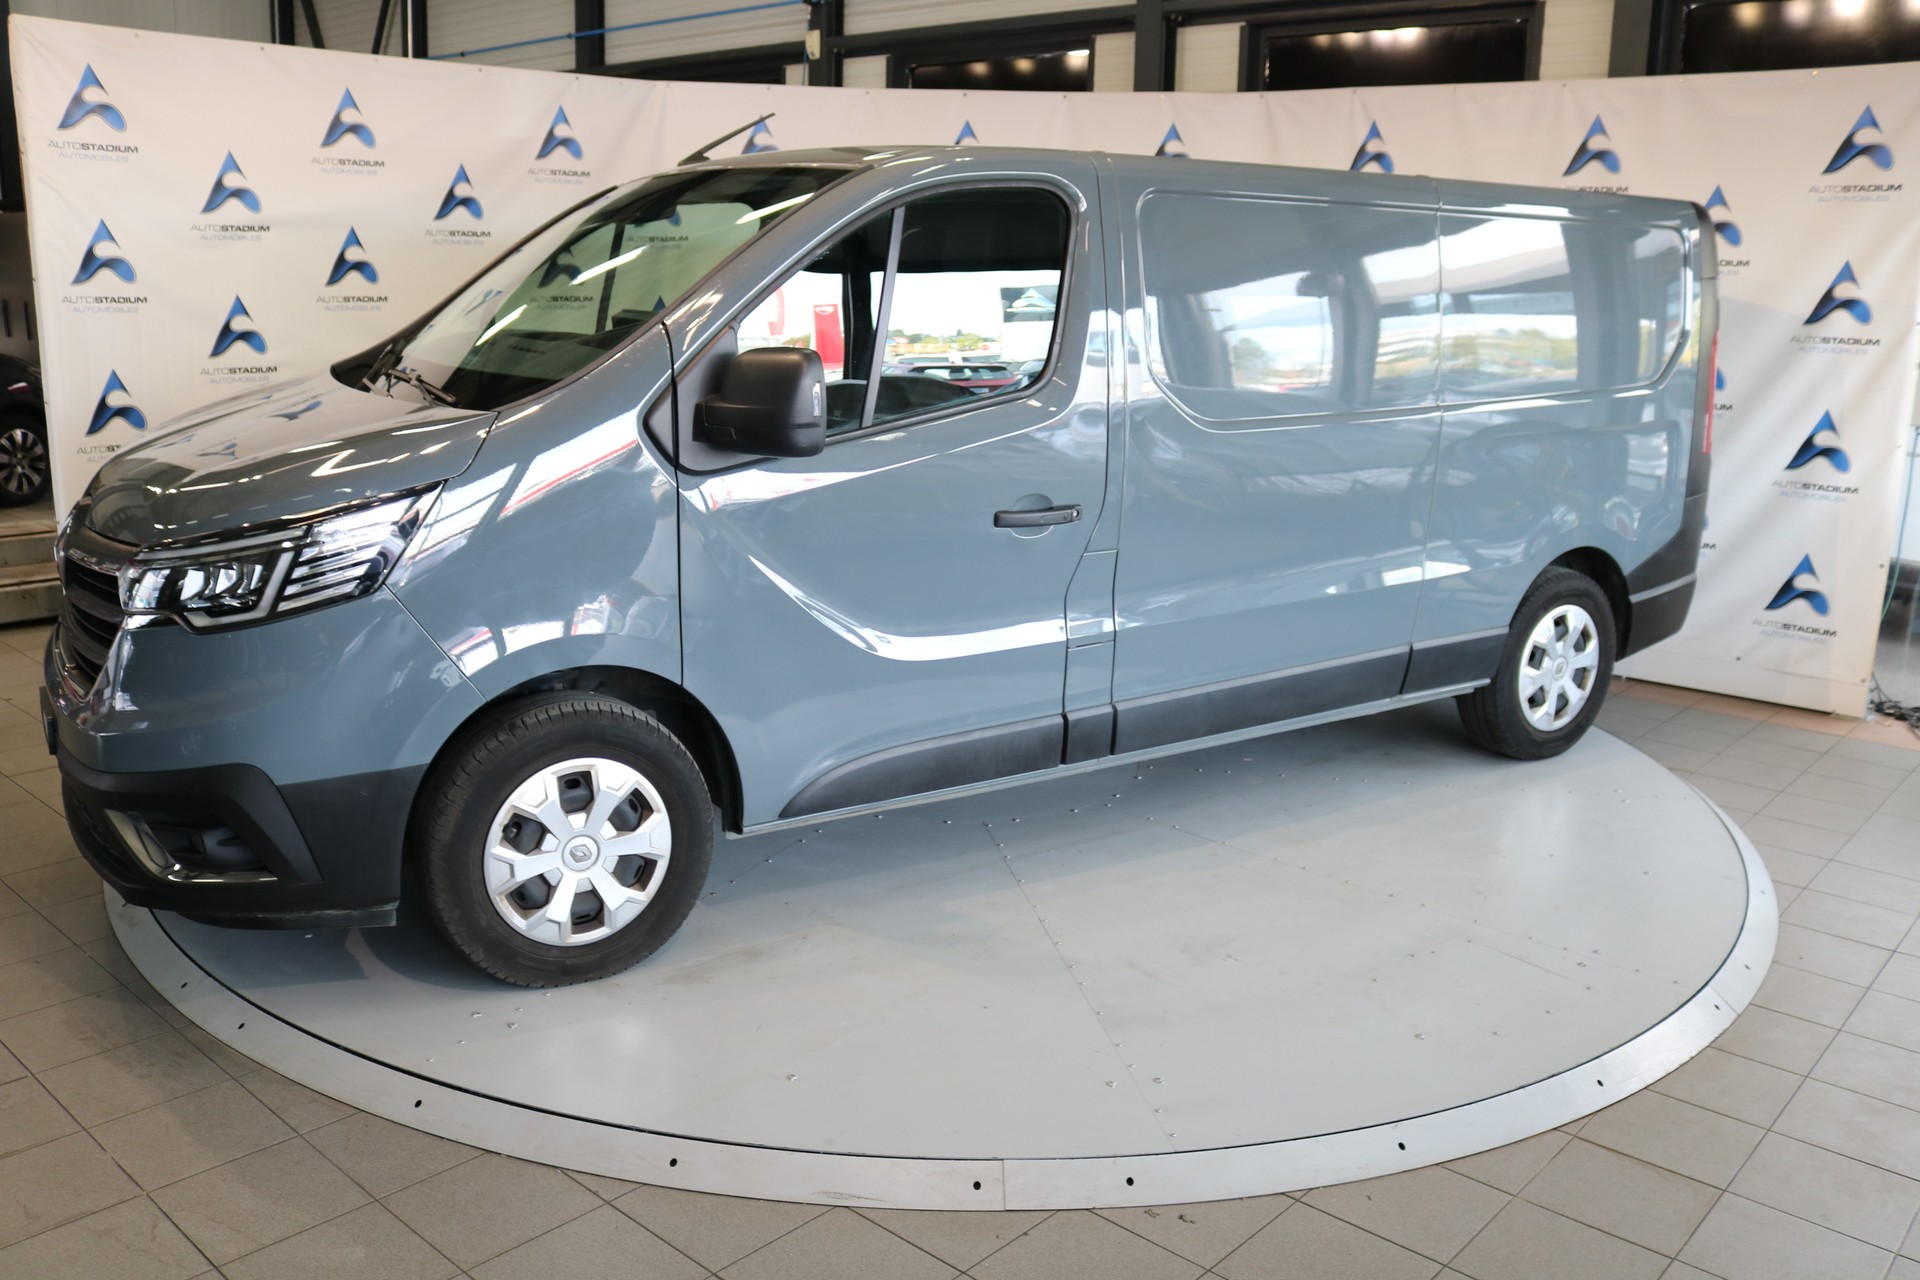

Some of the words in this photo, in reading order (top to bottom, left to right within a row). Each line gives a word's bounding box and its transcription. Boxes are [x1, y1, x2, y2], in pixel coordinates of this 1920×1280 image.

[48, 139, 139, 153] AUTOSTADIUM
[58, 152, 128, 162] AUTOMOBILES
[311, 157, 384, 167] AUTOSTADIUM
[320, 167, 378, 175] AUTOMOBILES
[527, 168, 590, 177] AUTOSTADIUM
[1809, 184, 1902, 193] AUTOSTADIUM
[191, 223, 270, 232] AUTOSTADIUM
[199, 233, 261, 241] AUTOMOBILES
[425, 229, 490, 238] AUTOSTADIUM
[62, 296, 148, 304] AUTOSTADIUM
[316, 295, 388, 303] AUTOSTADIUM
[530, 295, 594, 303] AUTOSTADIUM
[1790, 336, 1880, 346] AUTOSTADIUM
[200, 365, 278, 375] AUTOSTADIUM
[209, 375, 269, 383] AUTOMOBILES
[77, 445, 121, 454] AUTOST
[1772, 480, 1859, 494] AUTOSTADIUM
[1752, 618, 1836, 637] AUTOSTADIUM
